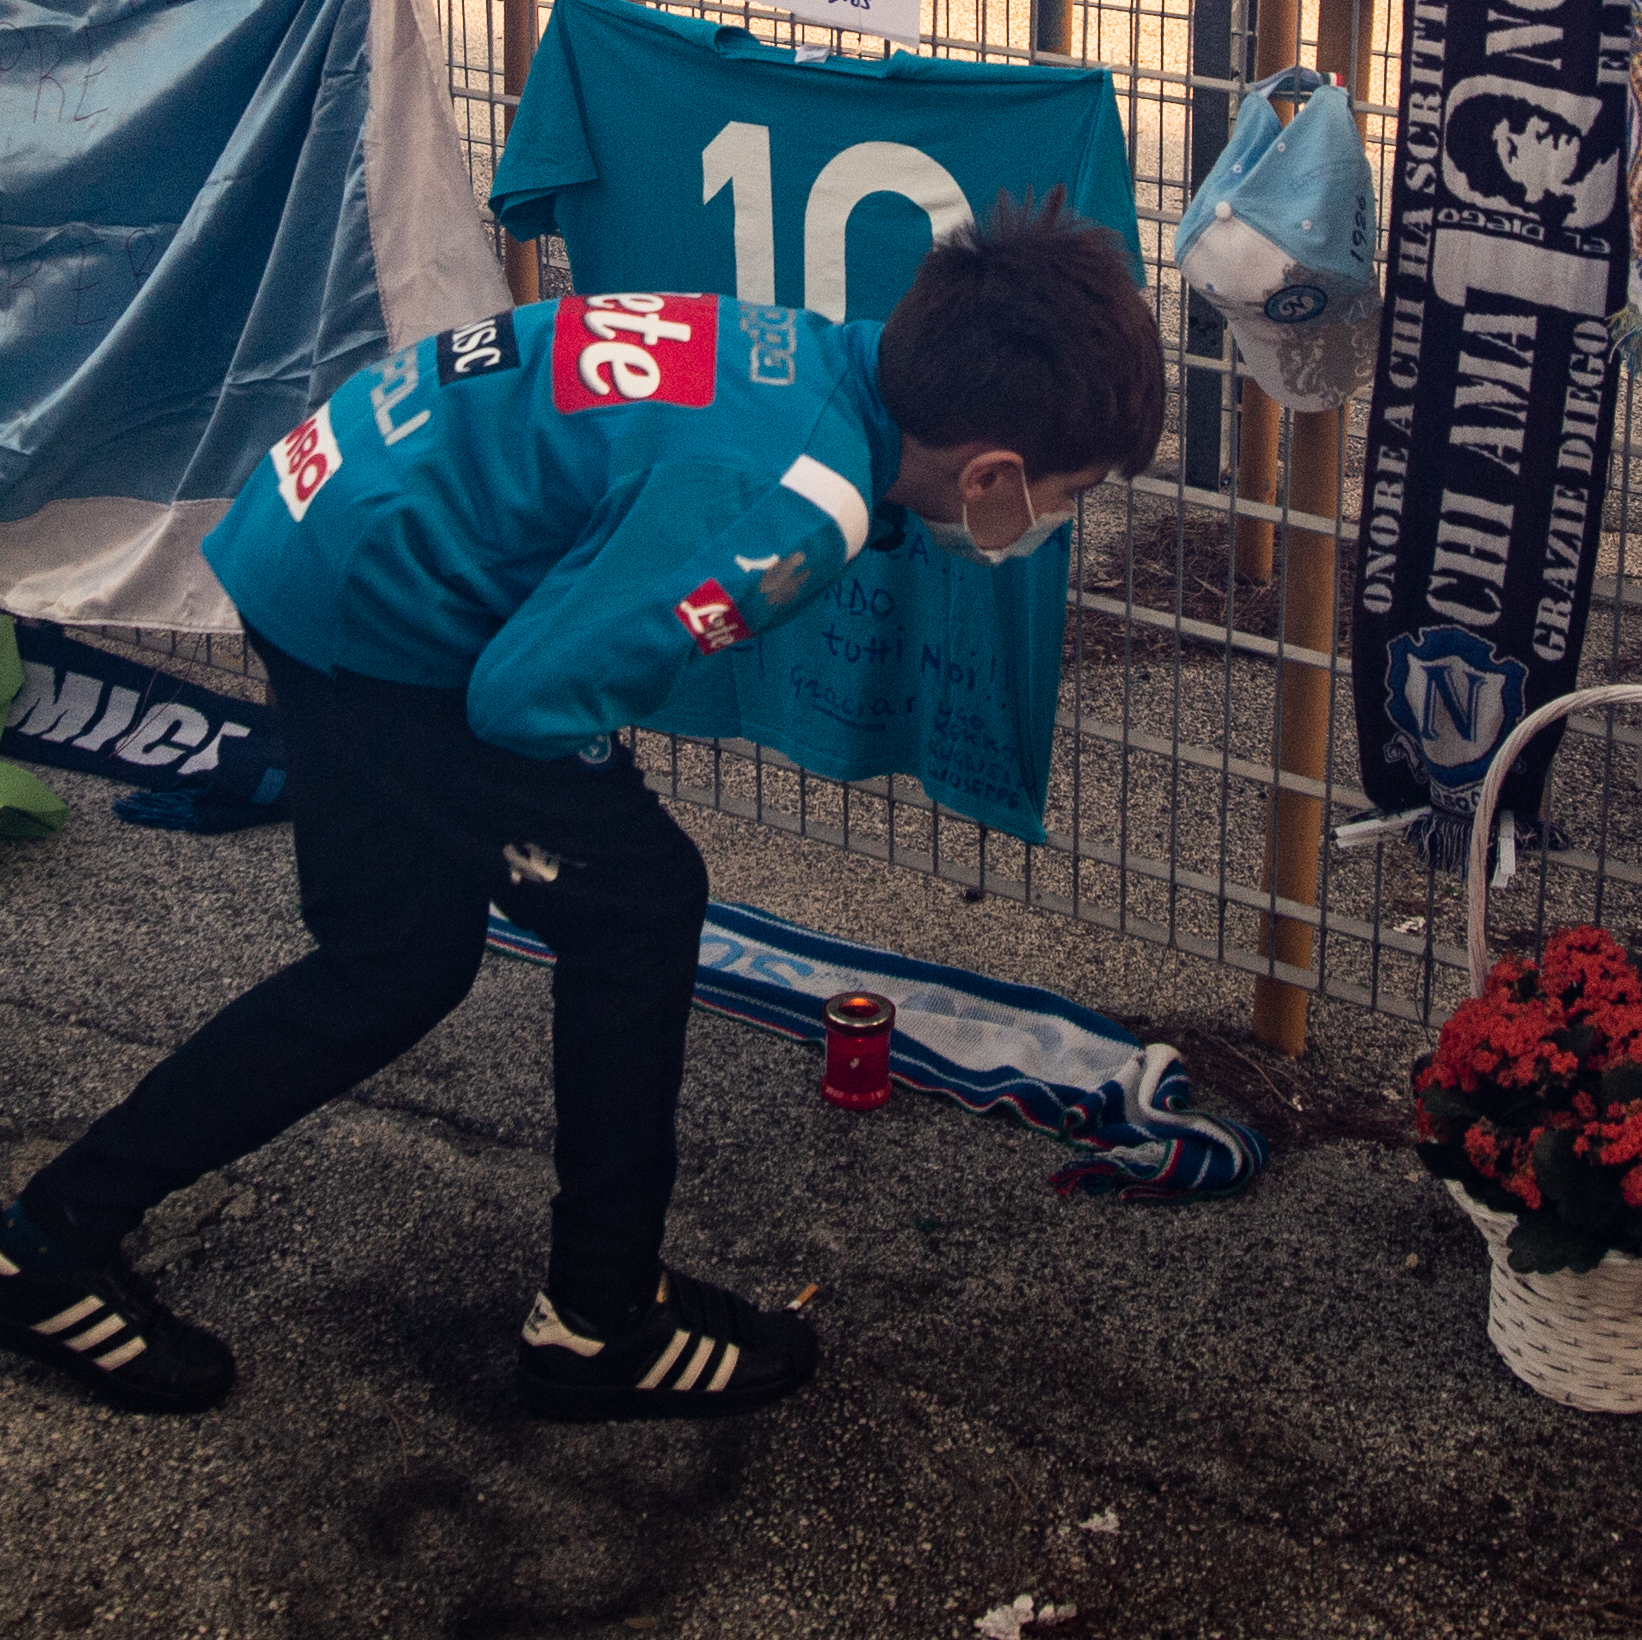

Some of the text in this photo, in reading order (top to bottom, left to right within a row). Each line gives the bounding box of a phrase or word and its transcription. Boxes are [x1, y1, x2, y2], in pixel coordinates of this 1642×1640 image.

[701, 120, 977, 323] 10
[1398, 207, 1434, 283] HA
[579, 292, 693, 401] ete
[1388, 297, 1424, 390] CHI
[1448, 312, 1538, 476] AMA
[1383, 404, 1415, 436] A
[1362, 444, 1409, 614] ONORE
[1426, 487, 1514, 627] CHI
[1532, 320, 1610, 661] GRAZIE DIEGO
